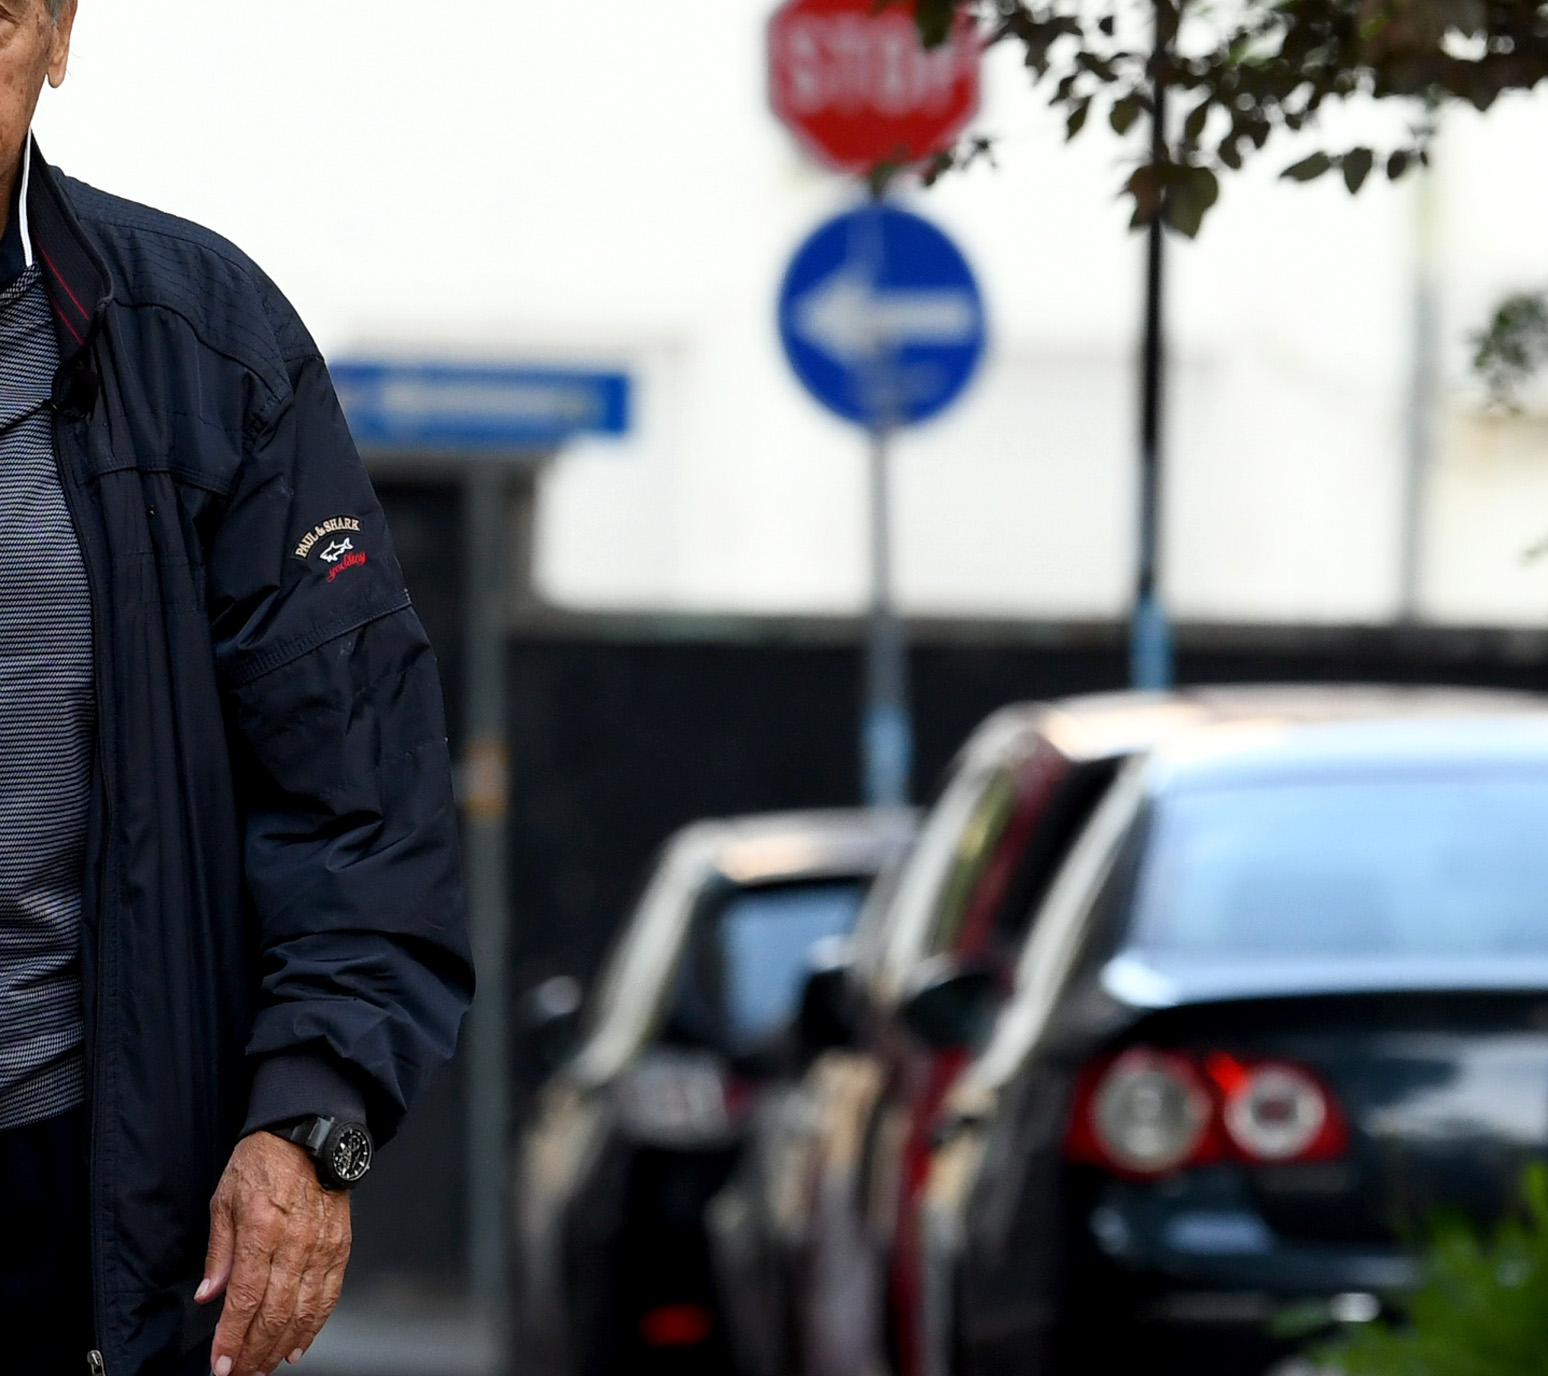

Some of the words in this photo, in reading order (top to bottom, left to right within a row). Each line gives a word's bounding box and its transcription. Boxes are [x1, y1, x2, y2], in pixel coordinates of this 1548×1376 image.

[784, 16, 962, 112] STOP
[294, 532, 320, 558] PAUL
[322, 516, 361, 533] SHARK
